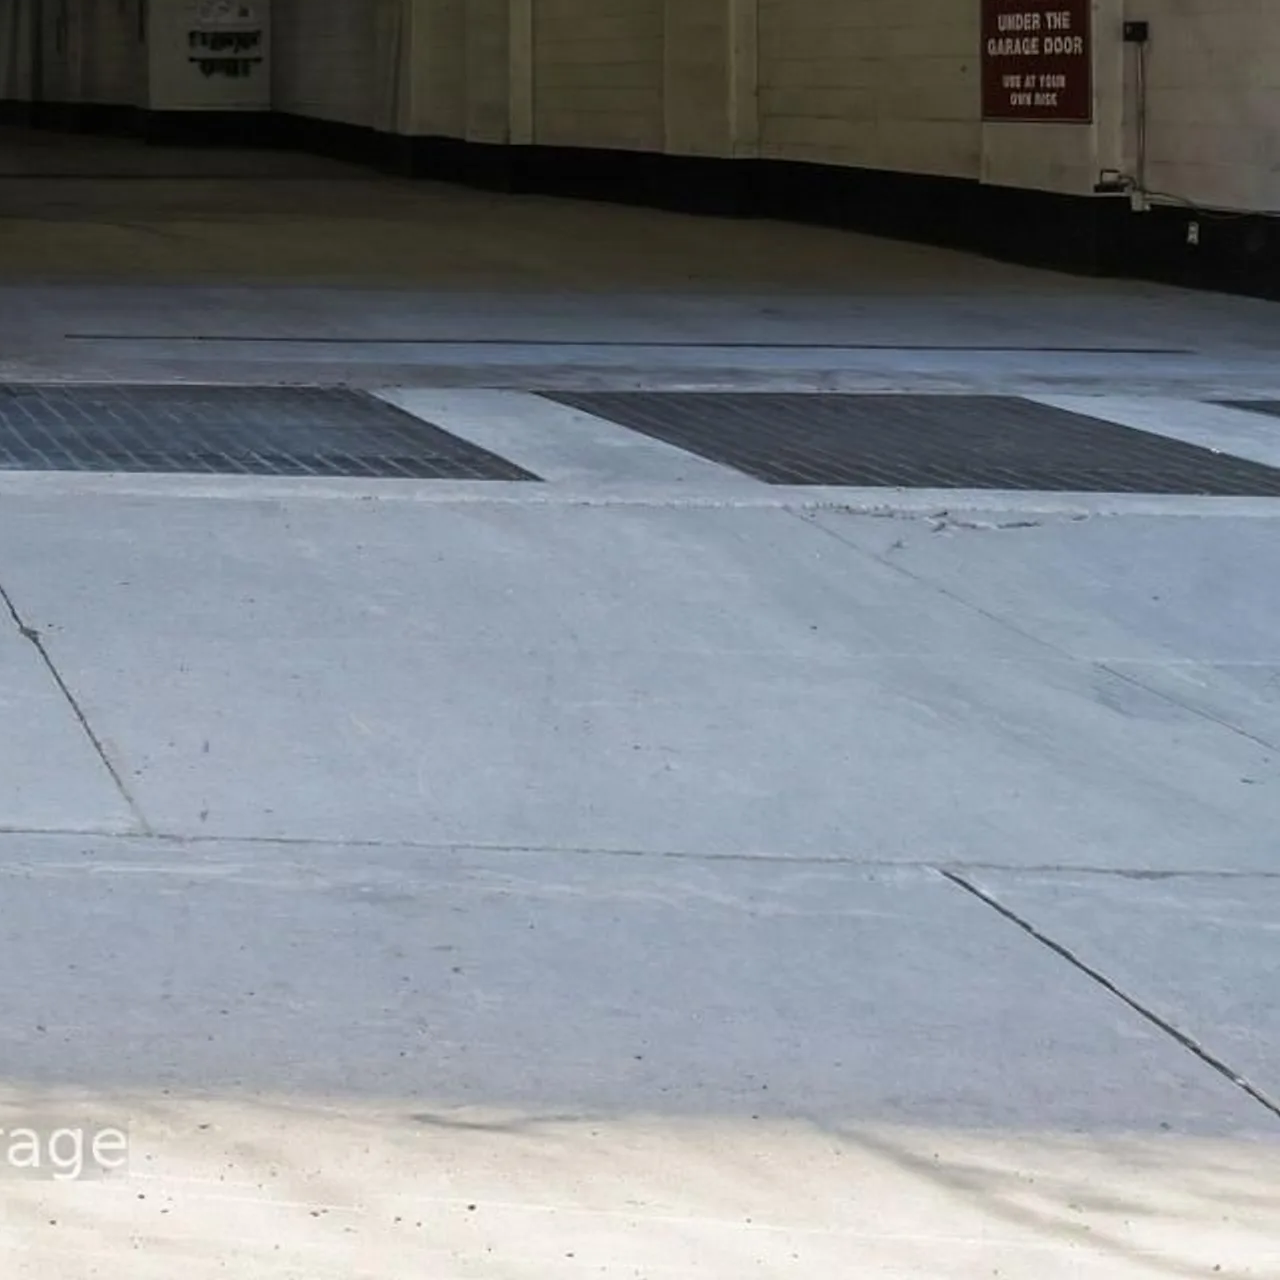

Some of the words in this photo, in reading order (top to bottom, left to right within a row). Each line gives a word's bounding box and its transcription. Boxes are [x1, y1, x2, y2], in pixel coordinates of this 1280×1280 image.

[998, 13, 1041, 32] UNDER
[1044, 12, 1071, 30] THE
[987, 37, 1040, 56] GARAGE
[1043, 36, 1083, 55] DOOR
[1024, 75, 1036, 88] AT
